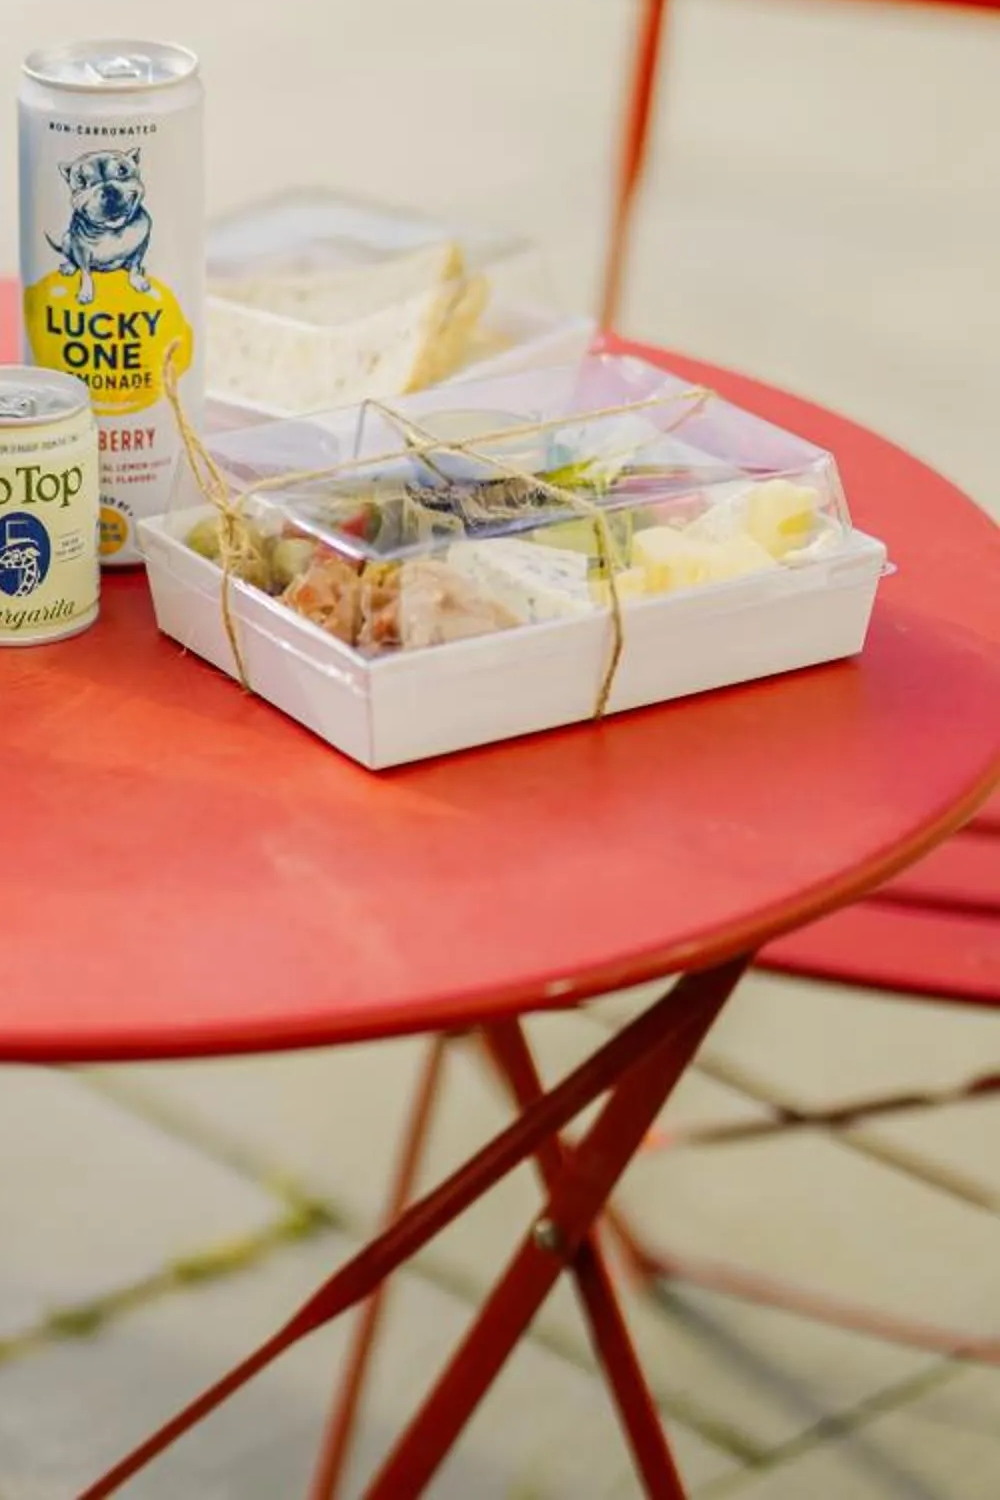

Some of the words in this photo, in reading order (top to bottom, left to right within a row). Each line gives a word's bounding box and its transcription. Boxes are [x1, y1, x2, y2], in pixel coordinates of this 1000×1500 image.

[46, 305, 162, 340] LUCKY
[63, 341, 141, 370] ONE
[76, 371, 152, 390] MONADE
[98, 428, 155, 452] BERRY
[16, 465, 83, 508] Top
